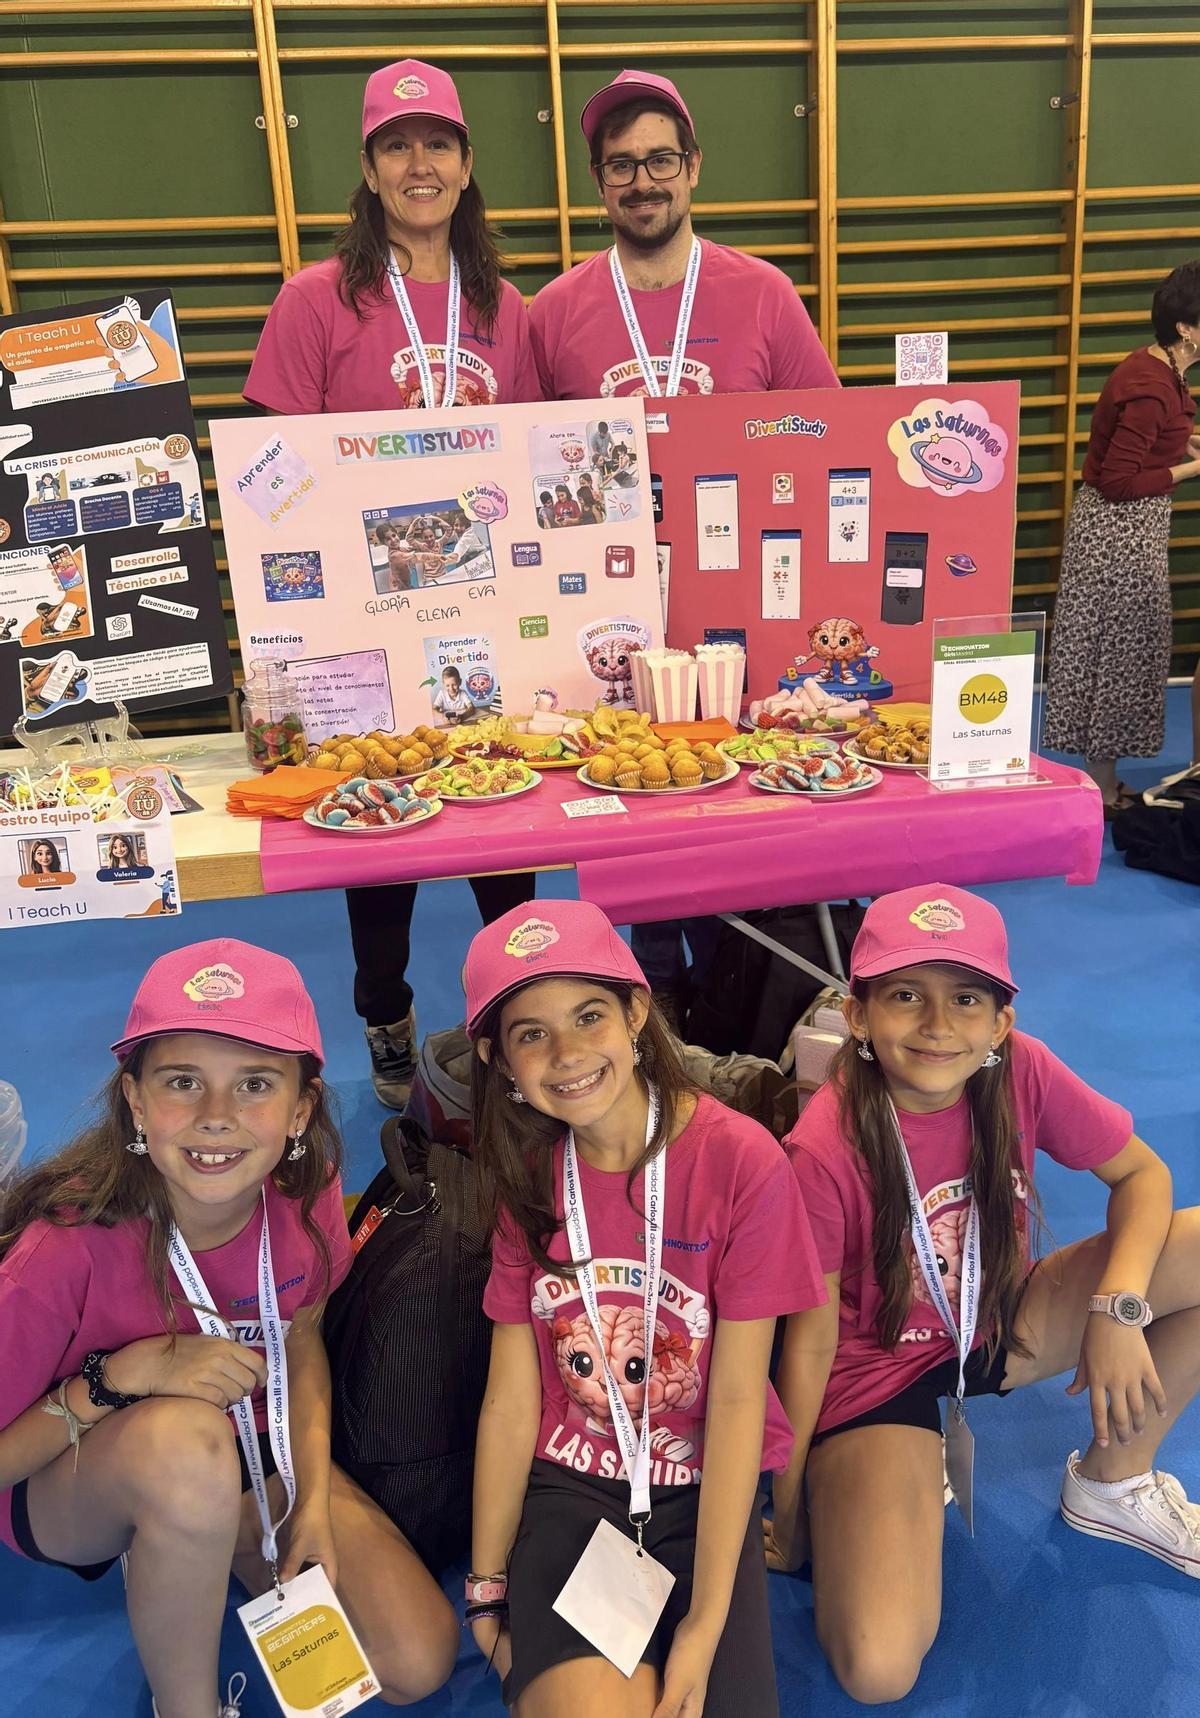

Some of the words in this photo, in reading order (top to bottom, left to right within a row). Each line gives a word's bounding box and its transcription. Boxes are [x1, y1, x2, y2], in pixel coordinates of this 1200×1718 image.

[27, 327, 68, 343] Teach
[72, 324, 81, 334] U
[6, 351, 16, 359] Un
[17, 347, 42, 358] puente
[44, 344, 53, 352] de
[746, 417, 826, 438] DivertiStudy
[901, 417, 931, 438] Las
[935, 411, 1002, 457] Saturnas
[338, 428, 495, 459] DIVERTISTUDY!
[9, 464, 22, 473] LA
[24, 459, 58, 471] CRISIS
[60, 456, 73, 465] DE
[75, 441, 161, 463] COMUNICACIÓN
[237, 440, 283, 492] Aprender
[270, 475, 284, 490] es
[270, 474, 315, 523] divertido!
[462, 490, 475, 501] Las
[475, 486, 504, 504] Saturnas
[514, 545, 538, 553] Lengua
[115, 551, 178, 568] Desarrollo
[109, 577, 157, 592] Técnico
[170, 571, 185, 581] IA.
[468, 585, 496, 599] EVA
[141, 598, 171, 612] ¿Usamos
[172, 605, 183, 613] IA?
[416, 606, 461, 623] ELENA
[520, 618, 546, 626] Ciencias
[110, 630, 131, 639] ChatGPT
[250, 634, 303, 645] Beneficios
[586, 622, 642, 640] DIVERTISTUDY
[438, 638, 477, 649] Aprender
[438, 651, 489, 666] Divertido
[329, 671, 355, 680] estudiar
[786, 666, 798, 681] B
[870, 671, 882, 684] D
[344, 682, 385, 691] conocimientos
[960, 691, 1008, 707] BM48
[314, 707, 358, 716] concentración
[953, 730, 968, 739] Las
[970, 727, 1012, 739] Saturnas
[41, 810, 90, 827] Equipo
[17, 903, 71, 919] Teach
[76, 902, 88, 914] U
[914, 908, 927, 917] Las
[927, 904, 961, 918] Saturnas
[508, 935, 519, 946] Las
[519, 924, 554, 935] Saturnas
[190, 975, 204, 986] Las
[205, 969, 242, 985] Saturnas
[569, 1176, 577, 1206] Carlos
[650, 1194, 658, 1224] Carlos
[911, 1204, 921, 1225] uc3m
[572, 1207, 586, 1257] Universidad
[650, 1233, 656, 1245] de
[917, 1225, 929, 1252] Madrid
[969, 1240, 975, 1251] de
[924, 1252, 931, 1263] de
[967, 1261, 975, 1284] Carlos
[263, 1265, 274, 1313] Universidad
[929, 1271, 940, 1292] Carlos
[964, 1285, 975, 1327] Universidad
[268, 1320, 278, 1341] uc3m
[271, 1343, 281, 1373] Madrid
[273, 1374, 282, 1386] de
[607, 1375, 619, 1402] Carlos
[273, 1387, 282, 1396] III
[273, 1396, 283, 1424] Carlos
[617, 1411, 626, 1424] de
[545, 1424, 594, 1472] LAS
[621, 1425, 636, 1458] Madrid
[275, 1426, 290, 1475] Universidad
[267, 1613, 326, 1653] BEGINNERS
[272, 1653, 293, 1673] Las
[292, 1628, 340, 1661] Saturnas
